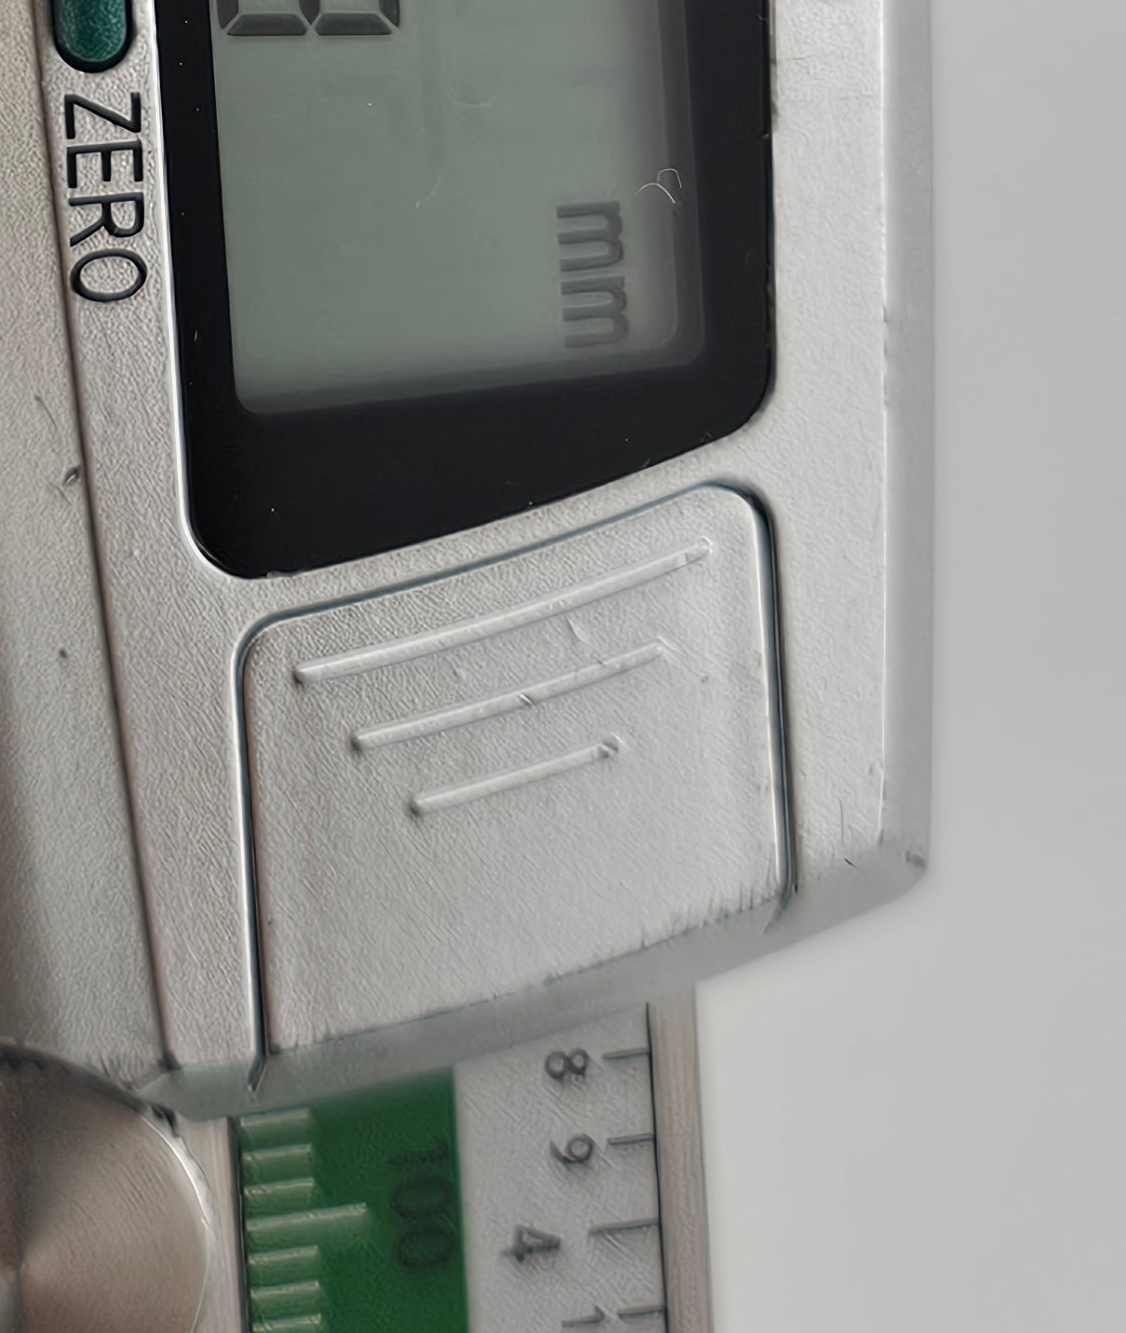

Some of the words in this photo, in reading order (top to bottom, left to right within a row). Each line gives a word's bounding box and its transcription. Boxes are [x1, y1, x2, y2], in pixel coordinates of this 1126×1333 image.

[63, 91, 148, 303] ZERO
[556, 200, 629, 349] mm
[545, 1048, 589, 1082] 8
[549, 1133, 594, 1166] 9
[389, 1143, 456, 1271] 100
[501, 1223, 562, 1263] 4
[562, 1305, 605, 1328] 1
